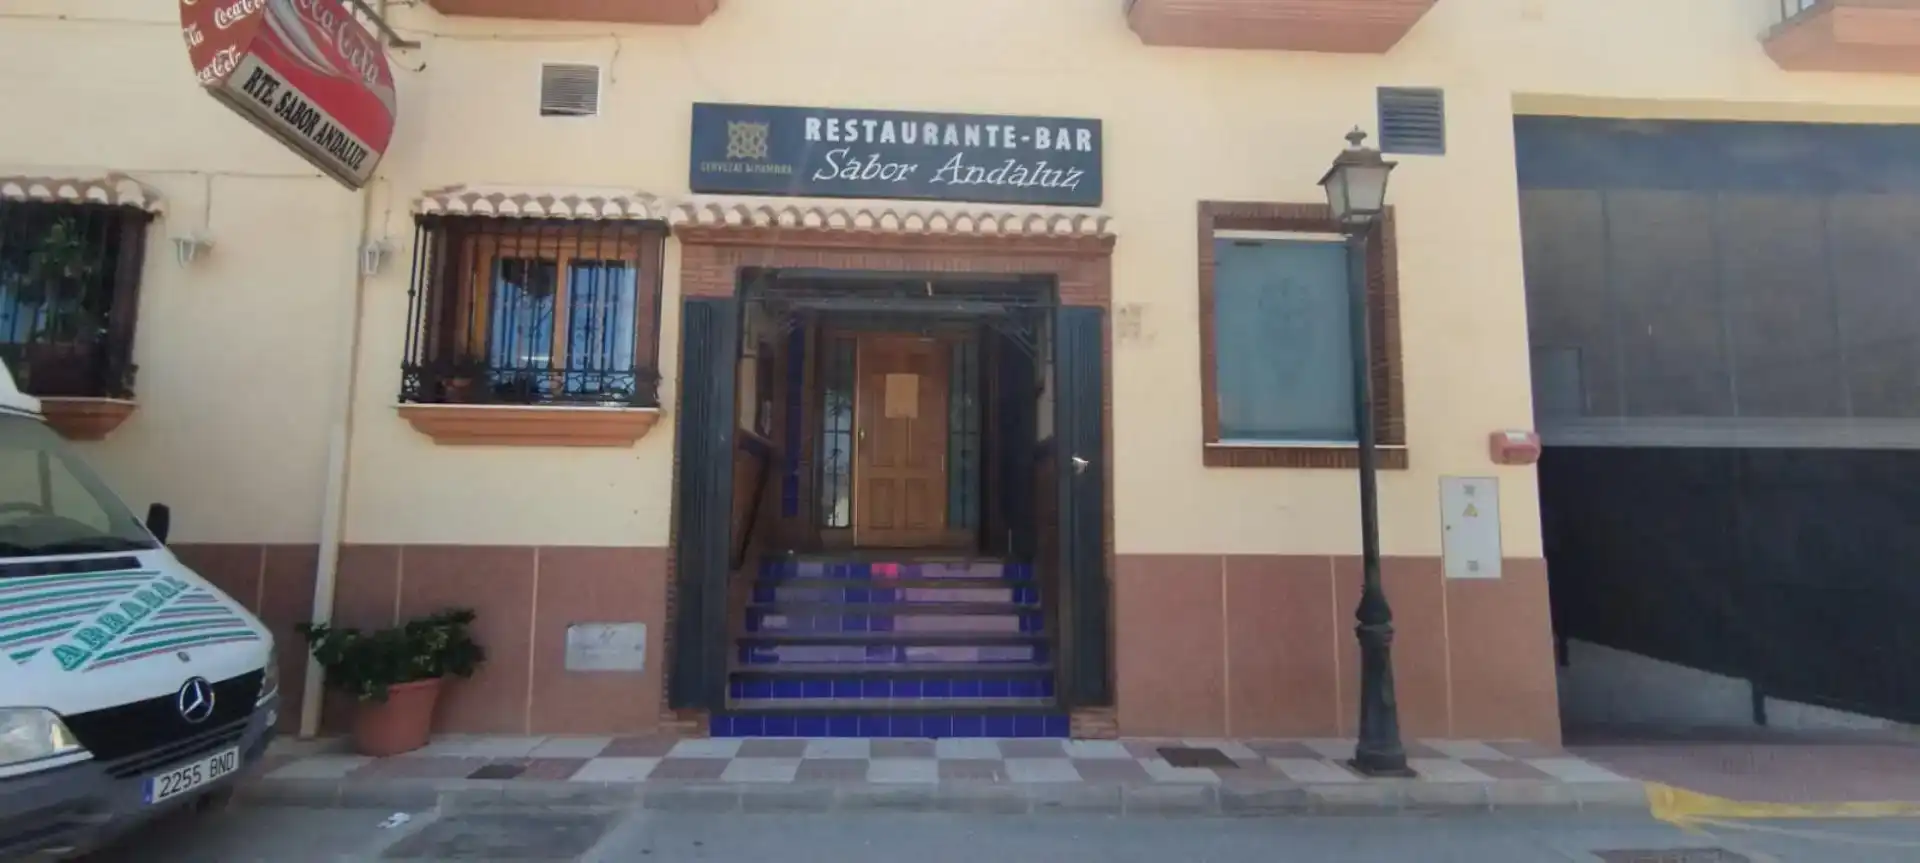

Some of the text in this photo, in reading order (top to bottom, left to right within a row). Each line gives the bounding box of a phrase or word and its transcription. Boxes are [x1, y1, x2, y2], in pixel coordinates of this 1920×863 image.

[274, 90, 321, 137] SABOR
[312, 121, 369, 171] ANDALUZ
[804, 117, 1092, 152] RESTAURANTE-BAR
[812, 147, 1086, 192] Sabor Andaluz
[159, 764, 202, 798] 2255
